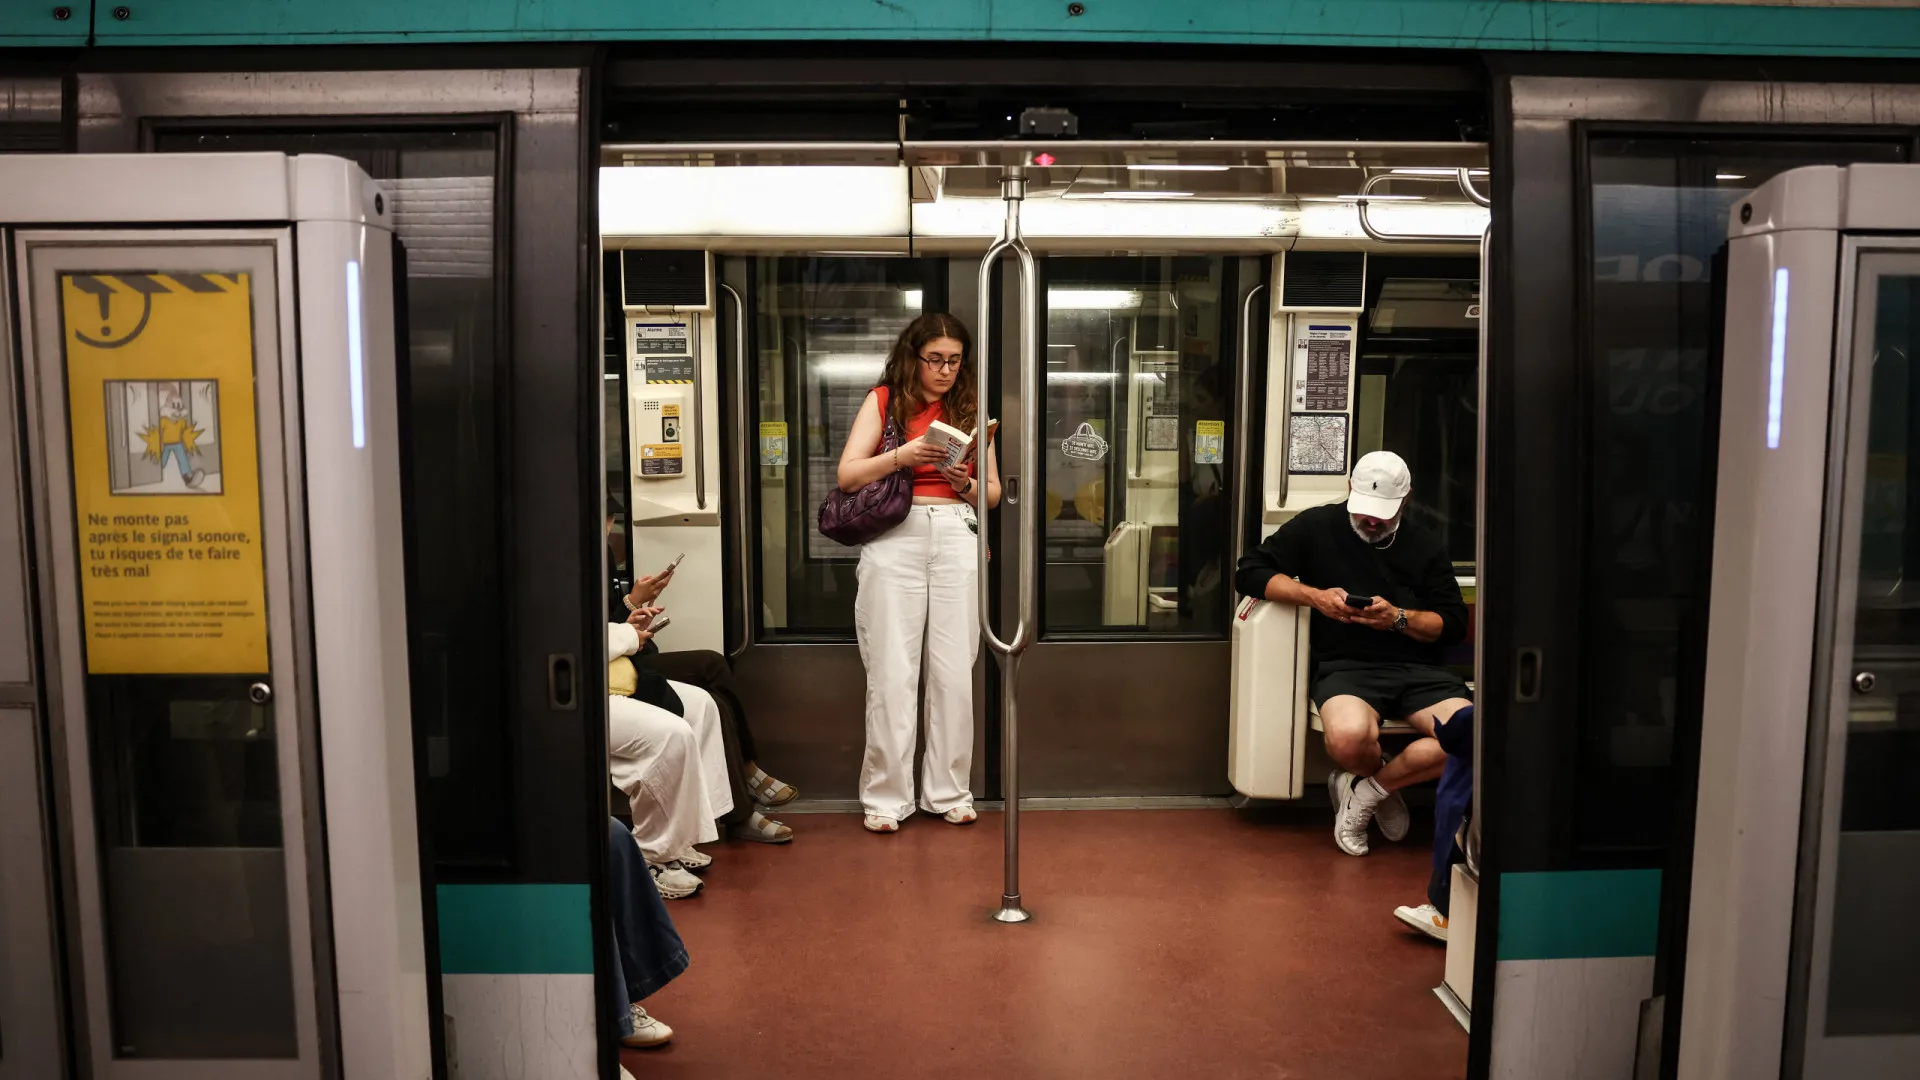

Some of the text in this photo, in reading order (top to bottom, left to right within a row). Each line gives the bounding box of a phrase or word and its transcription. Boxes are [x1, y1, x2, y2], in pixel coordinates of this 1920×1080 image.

[88, 514, 189, 528] Ne monte pas
[89, 530, 250, 545] après le signal sonore,
[90, 547, 241, 562] tu risques de te faire
[91, 564, 149, 577] très mal
